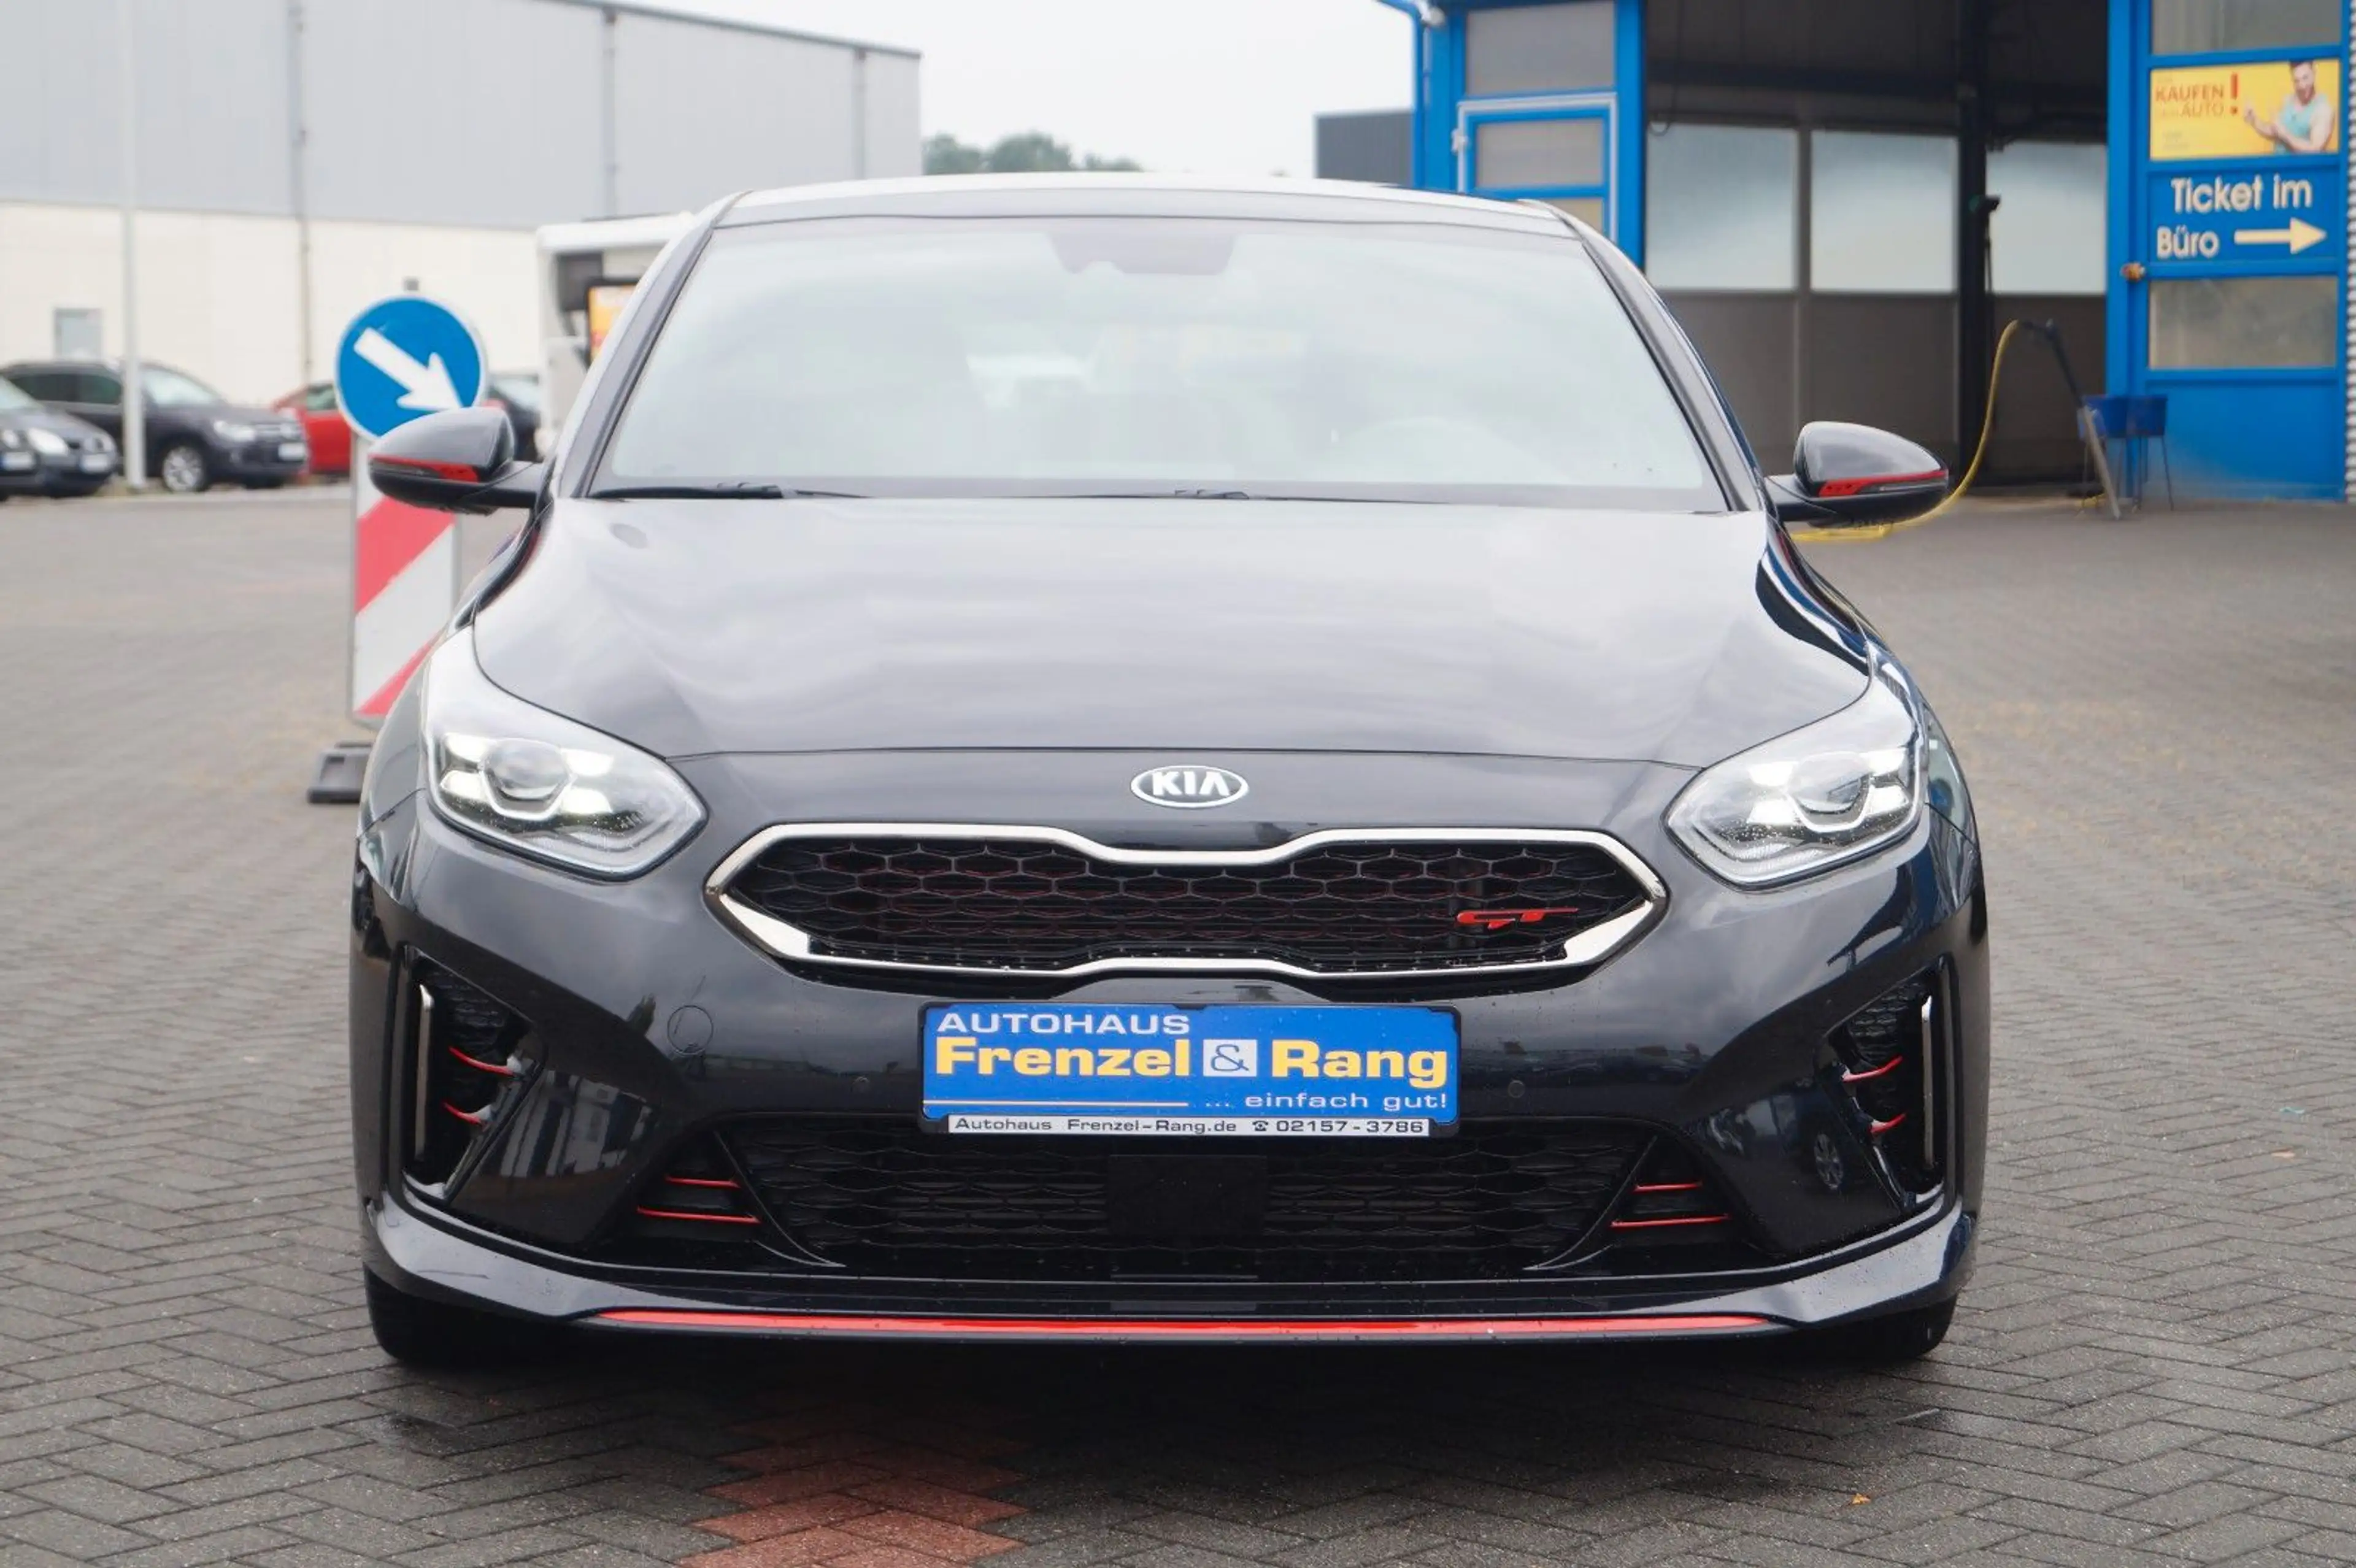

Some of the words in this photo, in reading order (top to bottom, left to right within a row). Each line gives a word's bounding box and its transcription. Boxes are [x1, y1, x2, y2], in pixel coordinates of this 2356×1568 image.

[2171, 174, 2263, 213] Ticket
[2273, 172, 2313, 209] im
[2157, 225, 2219, 259] Büro
[1152, 771, 1230, 796] KIA
[937, 1013, 1190, 1035] AUTOHAUS
[936, 1036, 1190, 1077] Frenzel
[1210, 1043, 1250, 1073] &
[1271, 1039, 1448, 1089] Rang
[1245, 1092, 1368, 1109] einfach
[1382, 1093, 1447, 1112] gut!
[954, 1117, 1052, 1131] Autohaus
[1067, 1118, 1237, 1135] Frenzel-Rang.de
